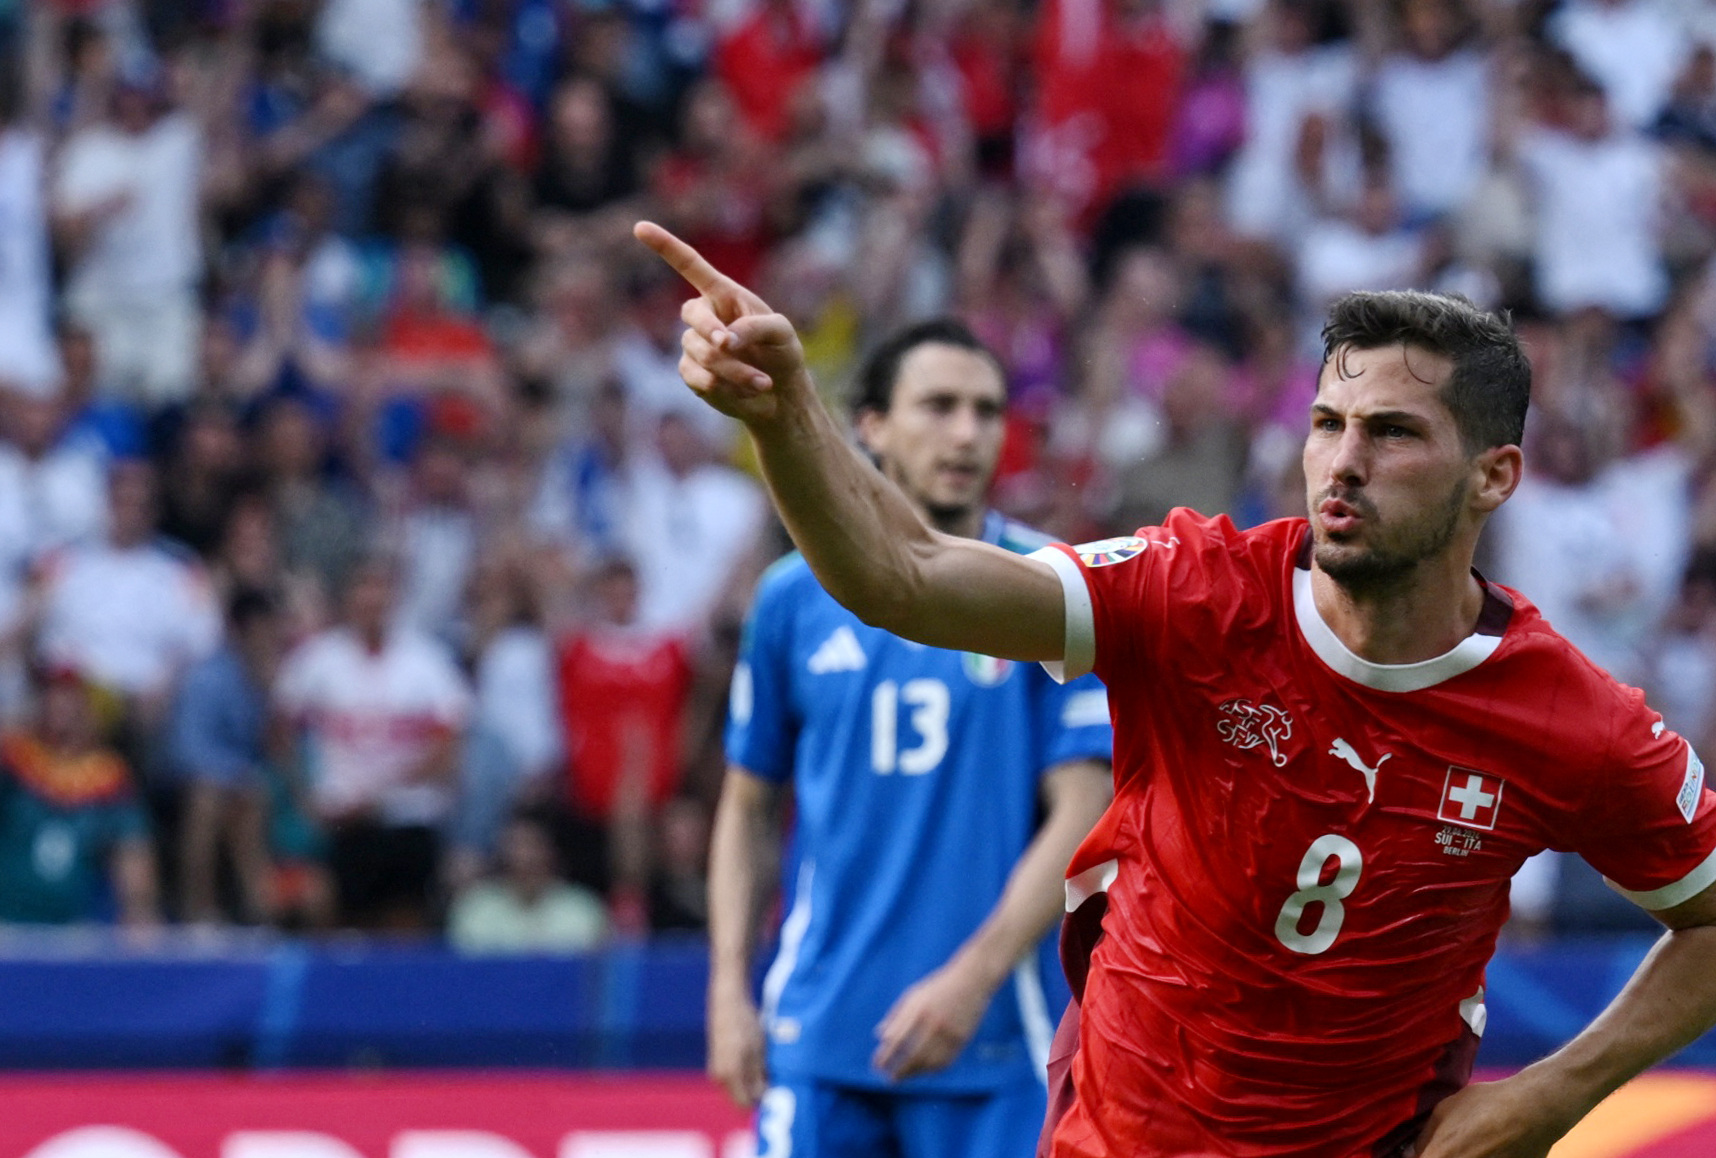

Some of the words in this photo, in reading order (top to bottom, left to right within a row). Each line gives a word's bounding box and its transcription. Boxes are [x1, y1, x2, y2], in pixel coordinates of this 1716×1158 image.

[870, 678, 951, 776] 13
[1434, 831, 1453, 846] SUI
[1463, 837, 1482, 851] ITA
[1443, 846, 1470, 857] BERLIN
[1274, 834, 1363, 954] 8
